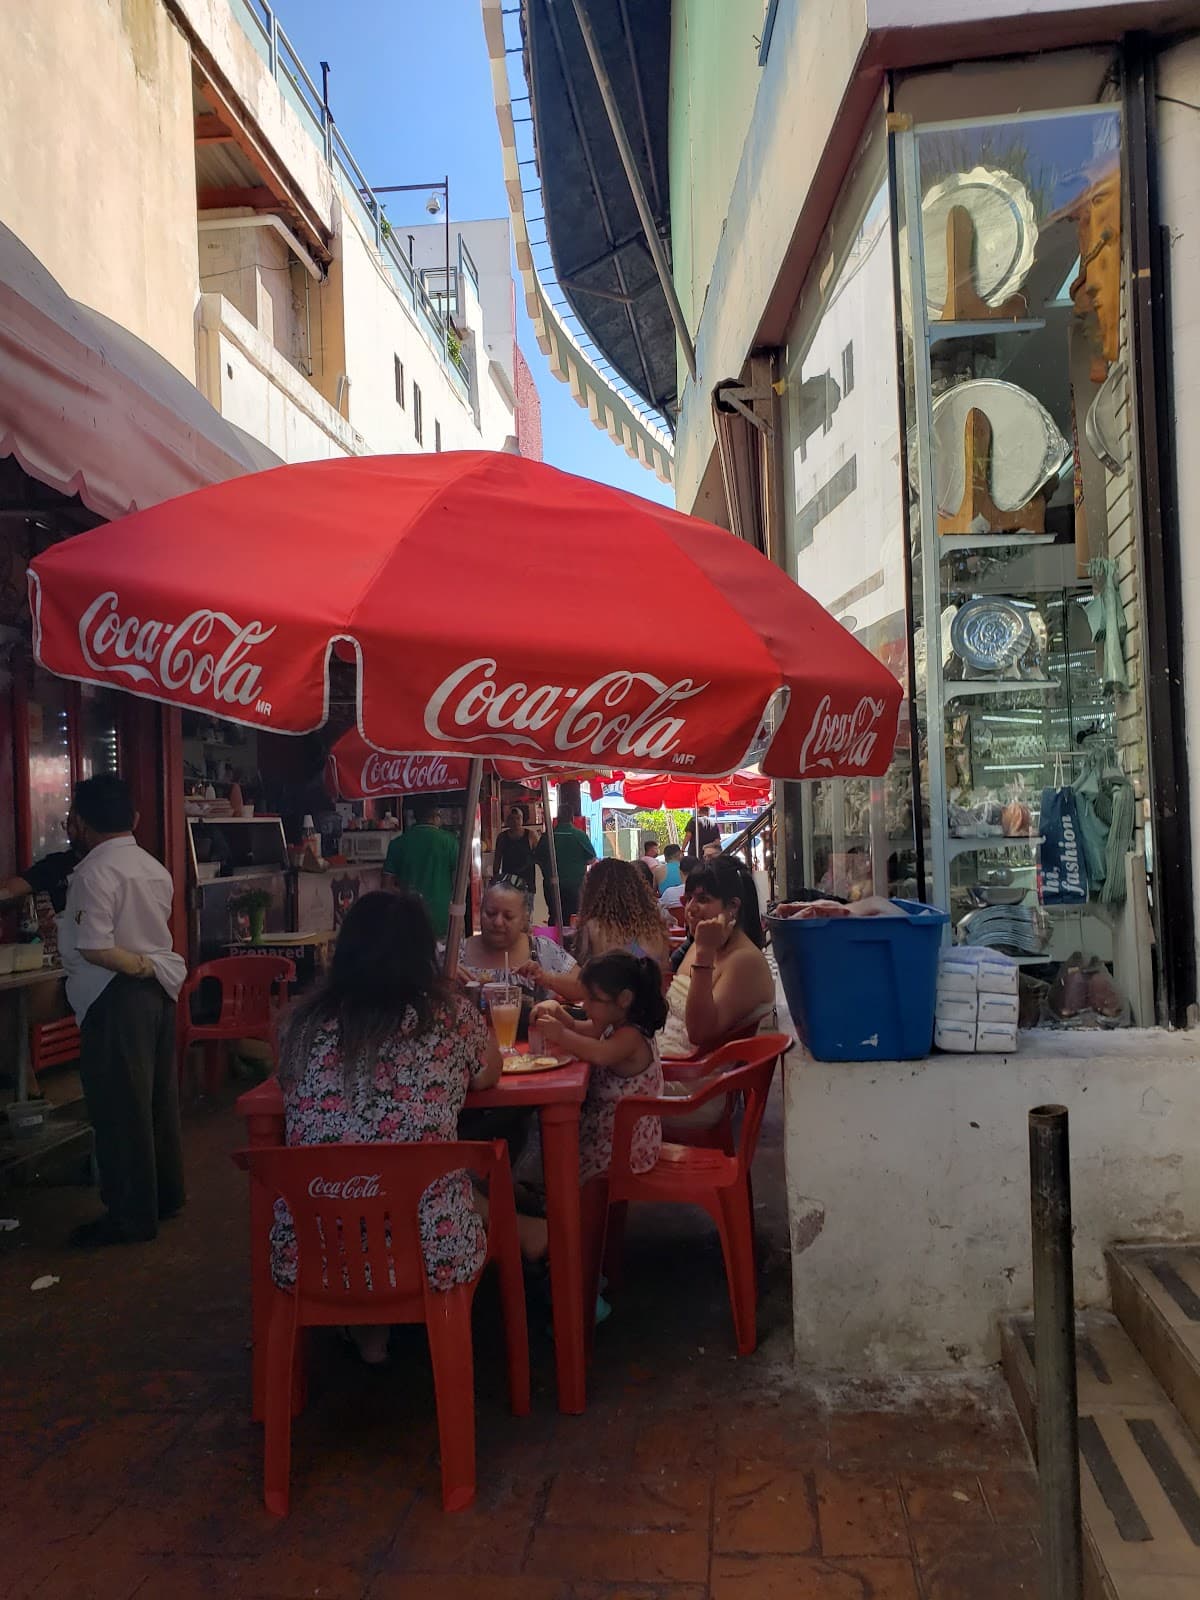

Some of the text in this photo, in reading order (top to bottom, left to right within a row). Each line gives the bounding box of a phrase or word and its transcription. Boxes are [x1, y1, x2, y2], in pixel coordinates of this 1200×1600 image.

[79, 591, 277, 716] Coca-Cola MR
[424, 658, 710, 766] Coca-Cola MR
[800, 695, 885, 774] Coca-Cla
[361, 753, 448, 794] Coca-Cola
[1058, 815, 1084, 896] fashion
[308, 1175, 381, 1199] Coca-Cola
